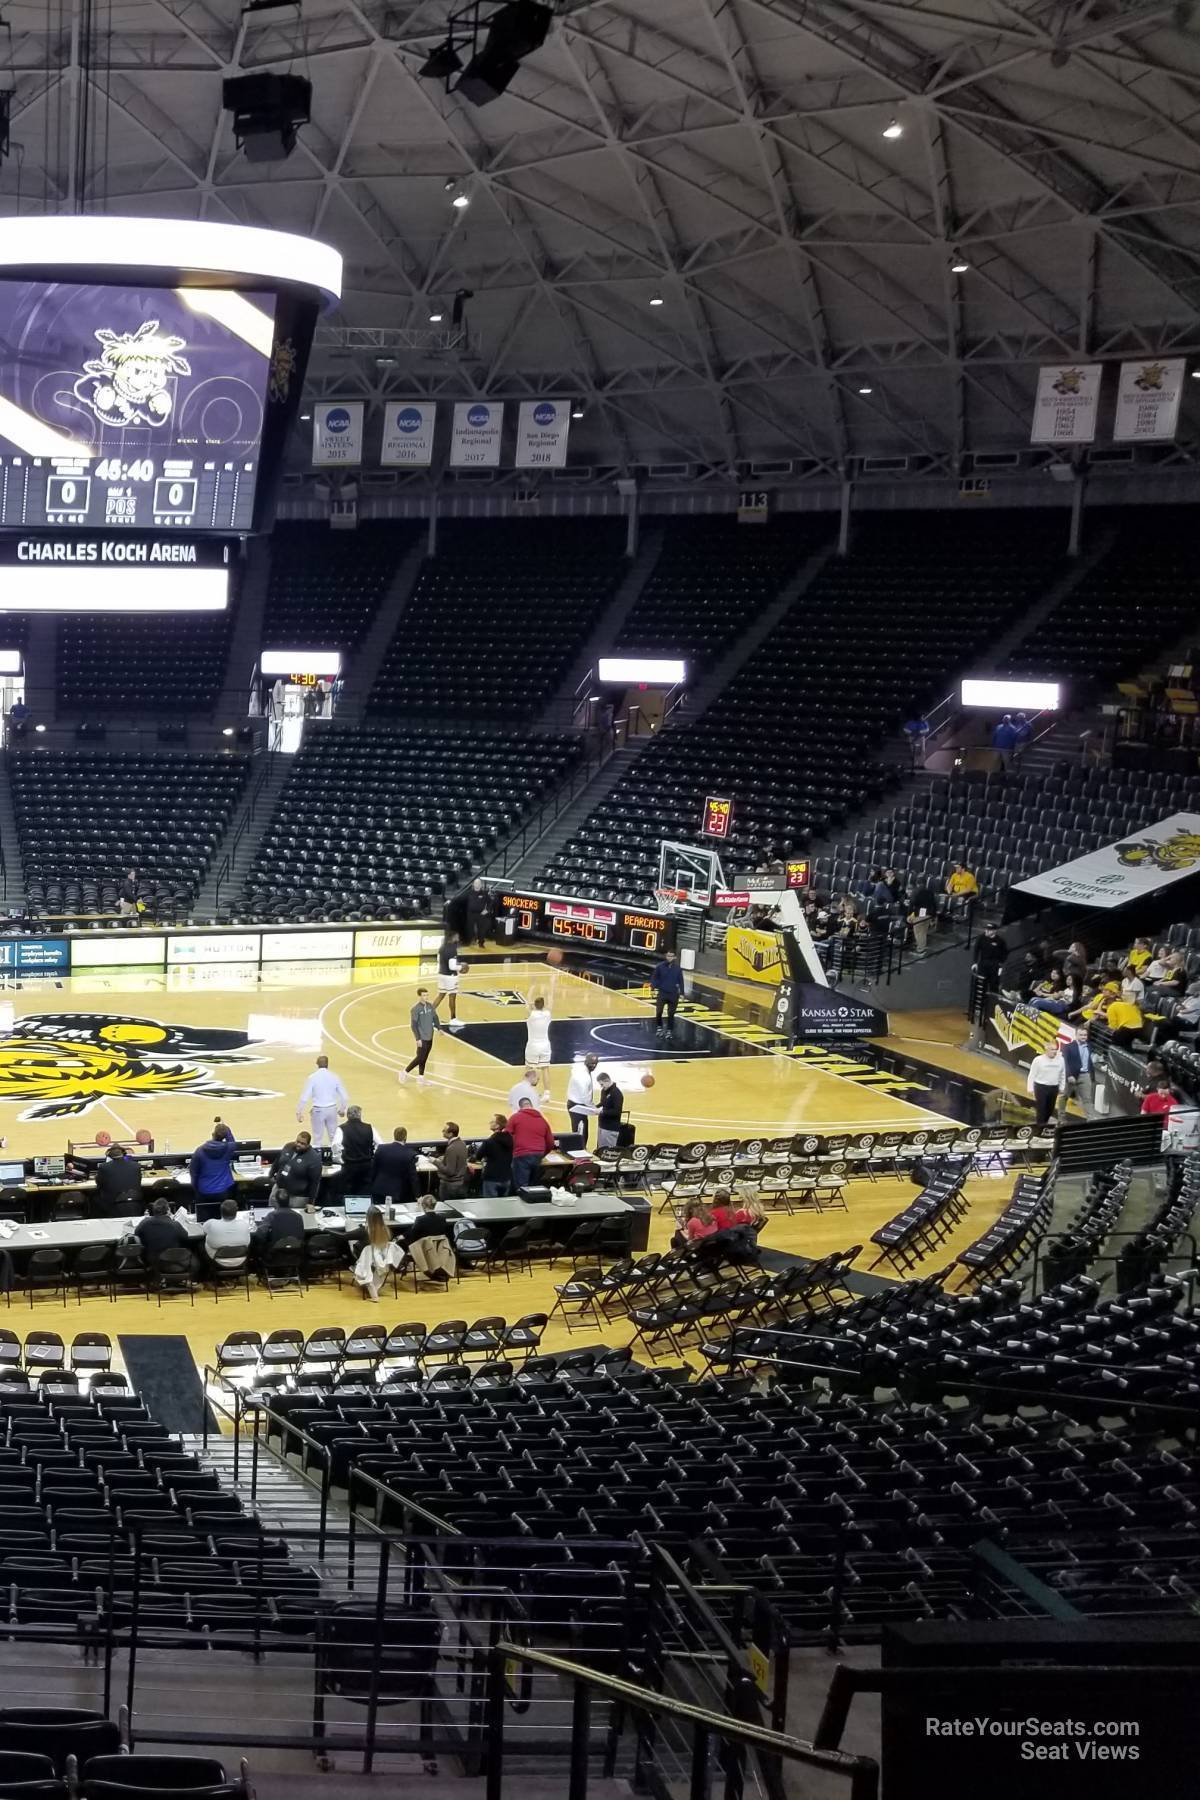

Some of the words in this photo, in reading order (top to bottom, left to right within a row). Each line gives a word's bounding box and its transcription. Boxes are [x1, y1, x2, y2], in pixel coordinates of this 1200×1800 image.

[328, 420, 349, 428] NCAA
[387, 441, 427, 449] REGIONAL
[462, 438, 492, 446] Regional
[327, 450, 347, 458] 2015
[396, 450, 416, 459] 2016
[532, 453, 551, 462] 2018
[61, 481, 76, 503] 0
[961, 479, 989, 491] 114
[168, 483, 183, 505] 0
[740, 493, 768, 507] 113
[106, 499, 136, 515] POS
[17, 541, 97, 560] CHARLES
[101, 542, 146, 561] KOCH
[150, 543, 196, 562] ARENA
[290, 673, 316, 685] 4:30
[709, 801, 728, 814] 45:40
[709, 813, 725, 832] 23
[790, 872, 803, 883] 23
[1051, 876, 1129, 897] Commerce
[1055, 886, 1096, 900] Bank
[502, 896, 539, 910] SHOCKERS
[522, 912, 531, 928] 0
[623, 914, 665, 930] BEARCATS
[554, 918, 594, 938] 45:40
[371, 935, 402, 947] FOLEY
[646, 933, 655, 948] 0
[801, 1008, 836, 1017] KANSAS
[850, 1007, 875, 1017] STAR
